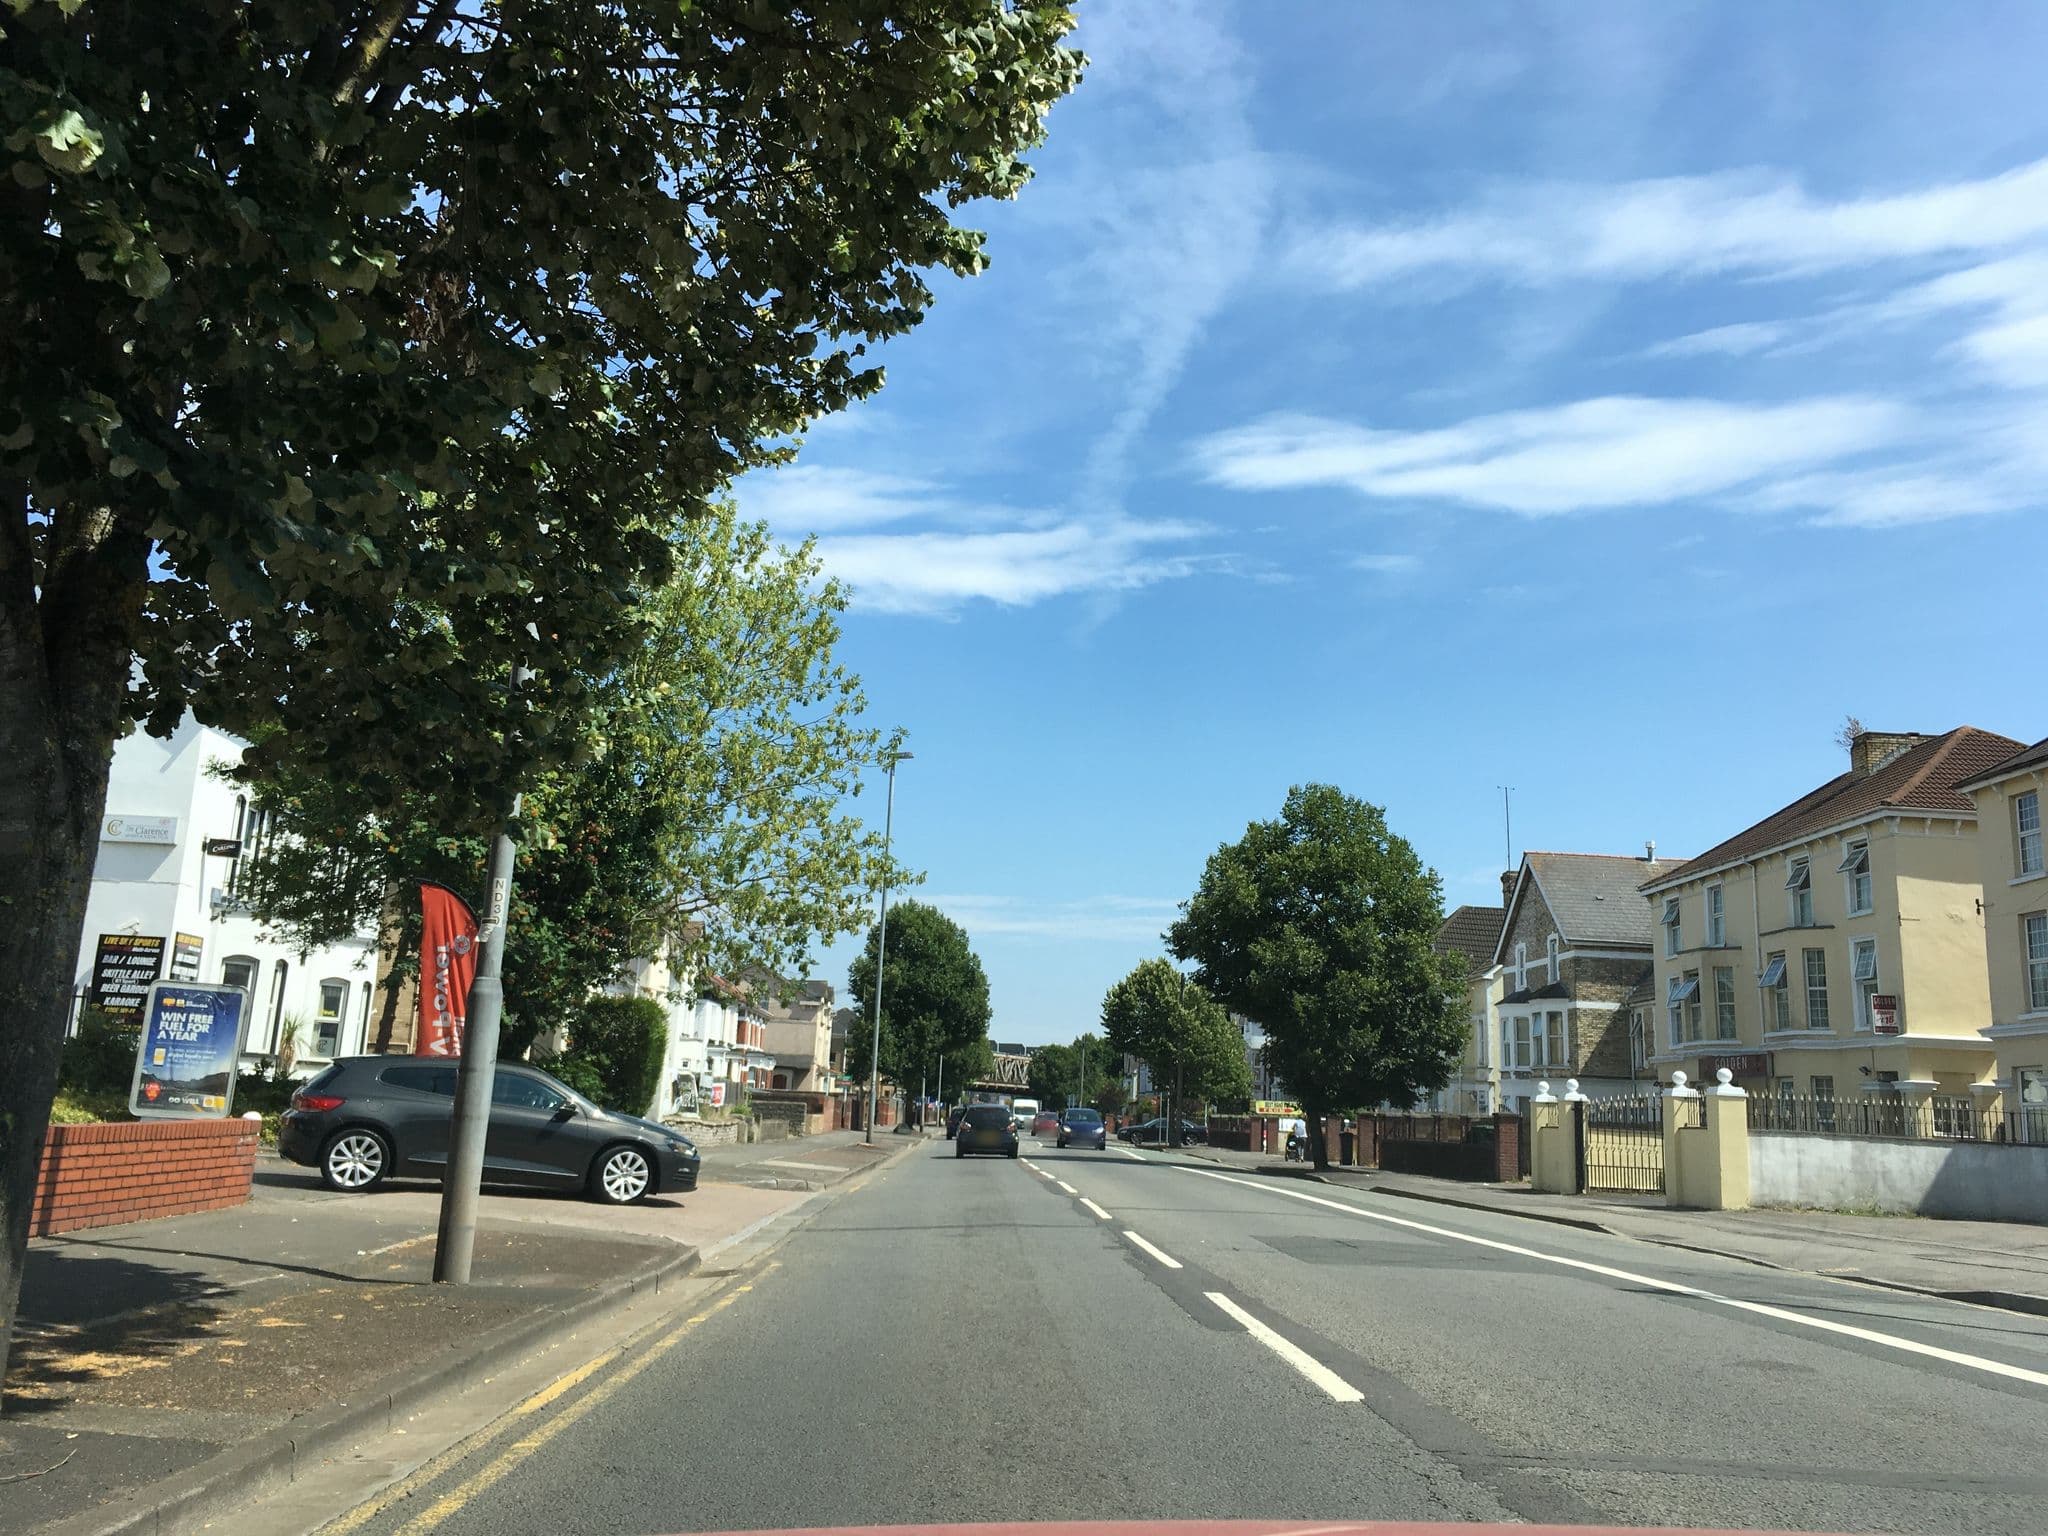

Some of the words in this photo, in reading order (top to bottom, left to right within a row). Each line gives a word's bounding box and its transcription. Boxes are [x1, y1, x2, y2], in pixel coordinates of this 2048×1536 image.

[135, 824, 168, 835] Clarence
[104, 936, 118, 945] LIVE
[133, 938, 160, 947] SPORTS
[102, 954, 118, 964] BAR
[127, 956, 157, 966] LOUNGE
[101, 968, 132, 978] SKITTLE
[130, 969, 155, 979] ALLEY
[100, 983, 119, 993] BEER
[103, 996, 141, 1007] KARAOKE
[161, 1011, 187, 1022] WIN
[188, 1013, 214, 1024] FREE
[159, 1020, 185, 1031] FUEL
[186, 1022, 210, 1033] FOR
[156, 1030, 167, 1040] A
[169, 1031, 197, 1041] YEAR
[1715, 1056, 1747, 1070] GOLDEN
[182, 1097, 199, 1105] WELL
